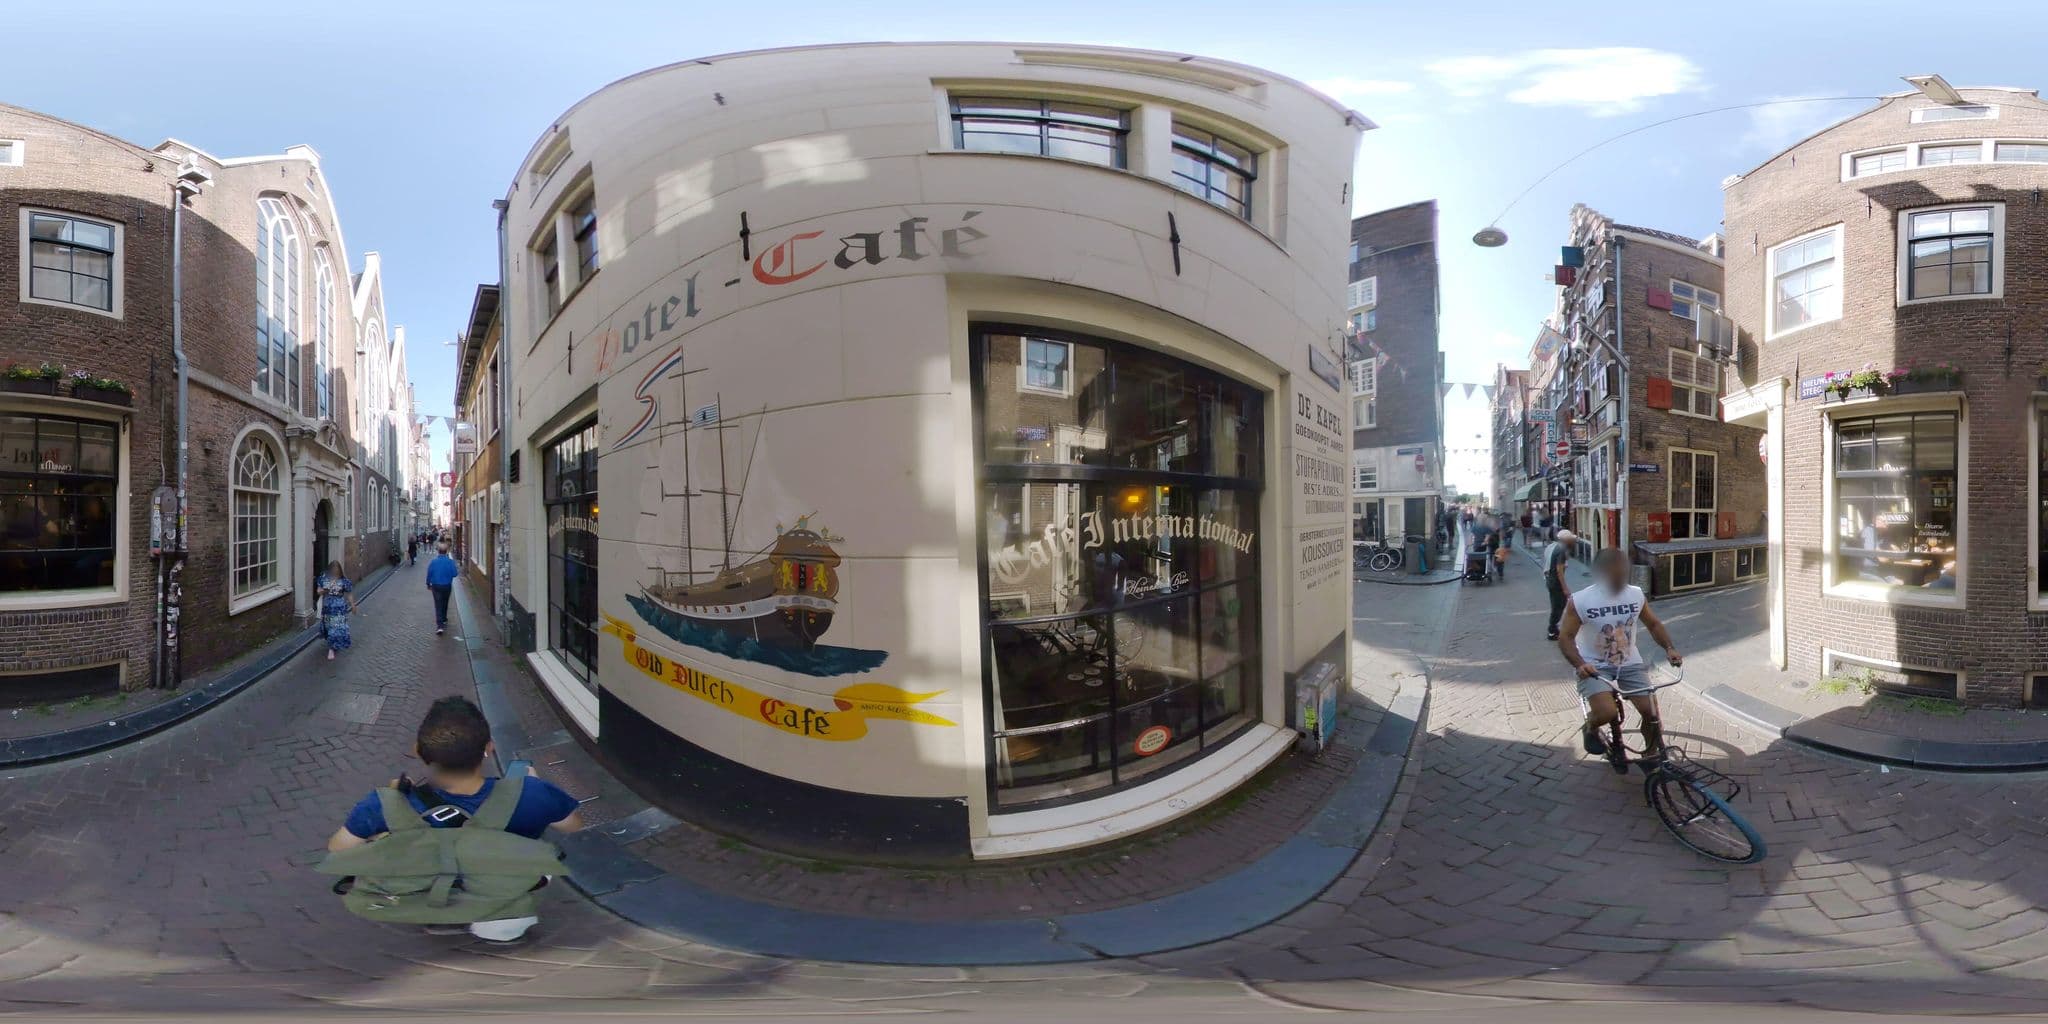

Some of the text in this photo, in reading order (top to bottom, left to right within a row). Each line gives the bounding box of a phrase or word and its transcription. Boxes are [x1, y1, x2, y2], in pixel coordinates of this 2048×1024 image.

[753, 210, 989, 285] Café
[1297, 391, 1342, 436] DE KAPEL
[991, 512, 1075, 584] Café
[1586, 602, 1639, 619] SPICE
[635, 647, 663, 676] Old
[760, 698, 831, 735] Café
